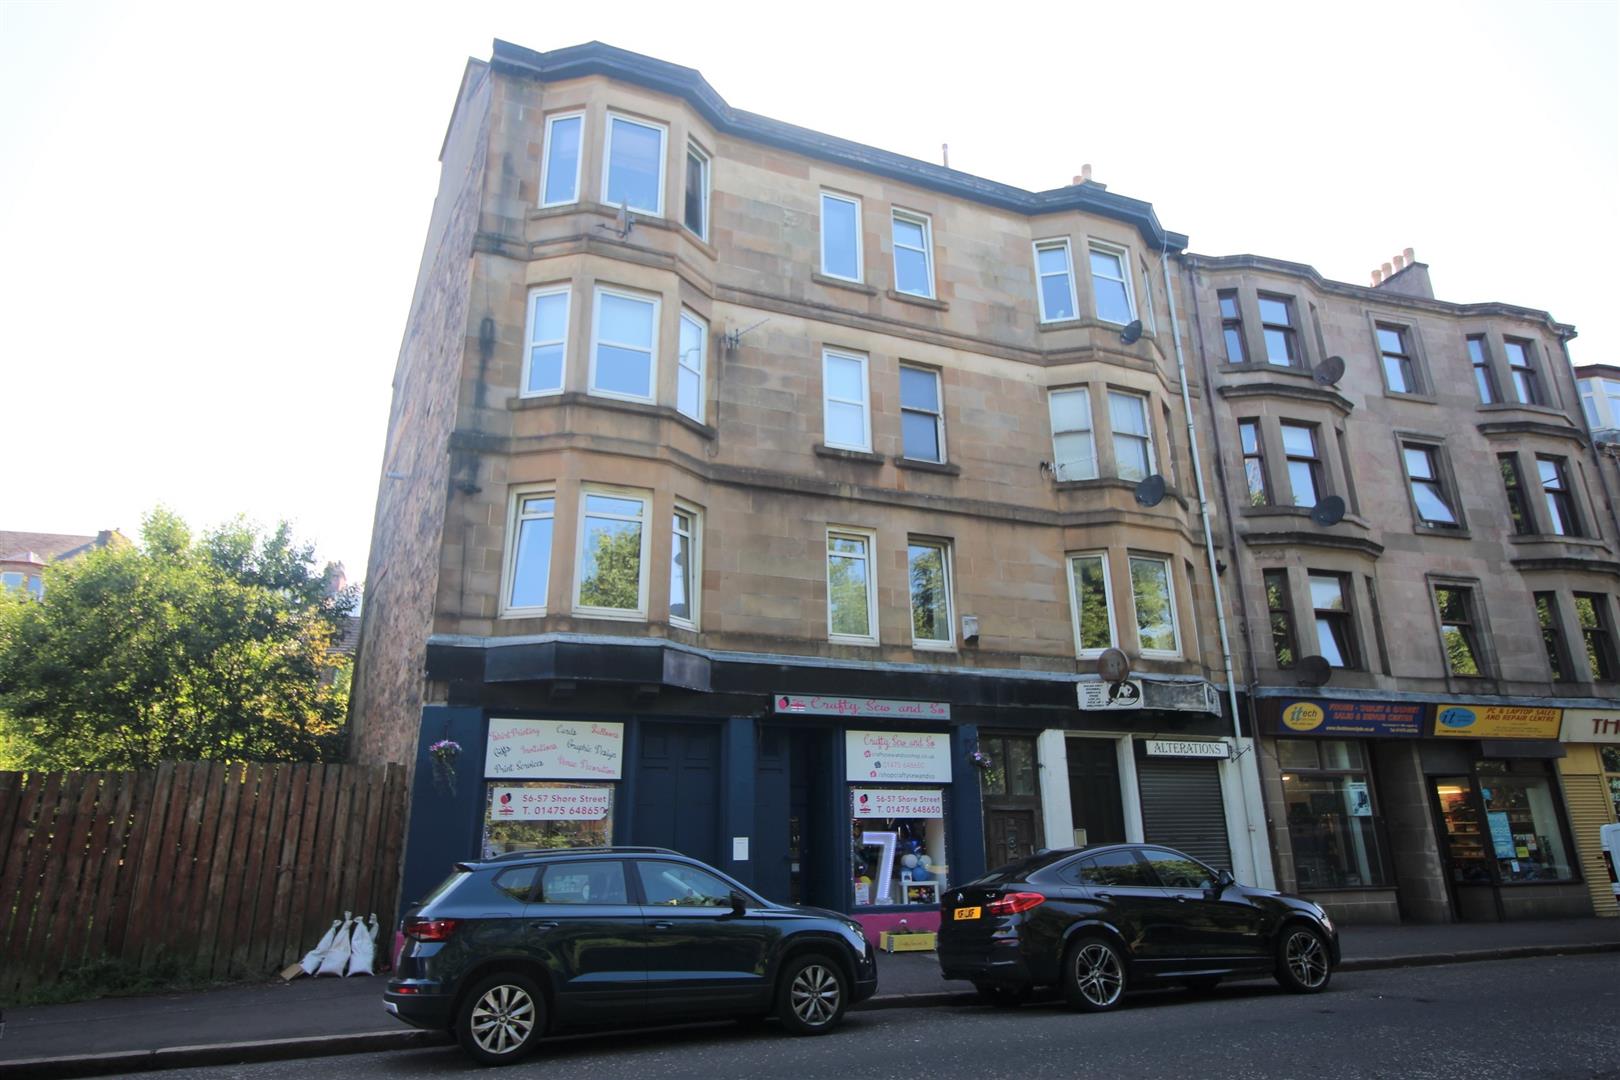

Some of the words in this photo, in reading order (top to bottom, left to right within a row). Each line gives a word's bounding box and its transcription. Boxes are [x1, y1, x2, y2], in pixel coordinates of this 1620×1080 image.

[810, 696, 859, 715] Crafty
[865, 698, 890, 712] Sew
[898, 702, 923, 713] and
[930, 703, 945, 714] So
[1502, 714, 1527, 722] REPAIR
[863, 734, 889, 750] Crafty
[1153, 742, 1222, 755] ALTERATIONS
[522, 794, 548, 803] 56-57
[551, 794, 577, 803] Shore
[580, 794, 607, 803] Street
[898, 795, 918, 803] Shore
[919, 795, 940, 803] Street
[534, 806, 566, 815] 01475
